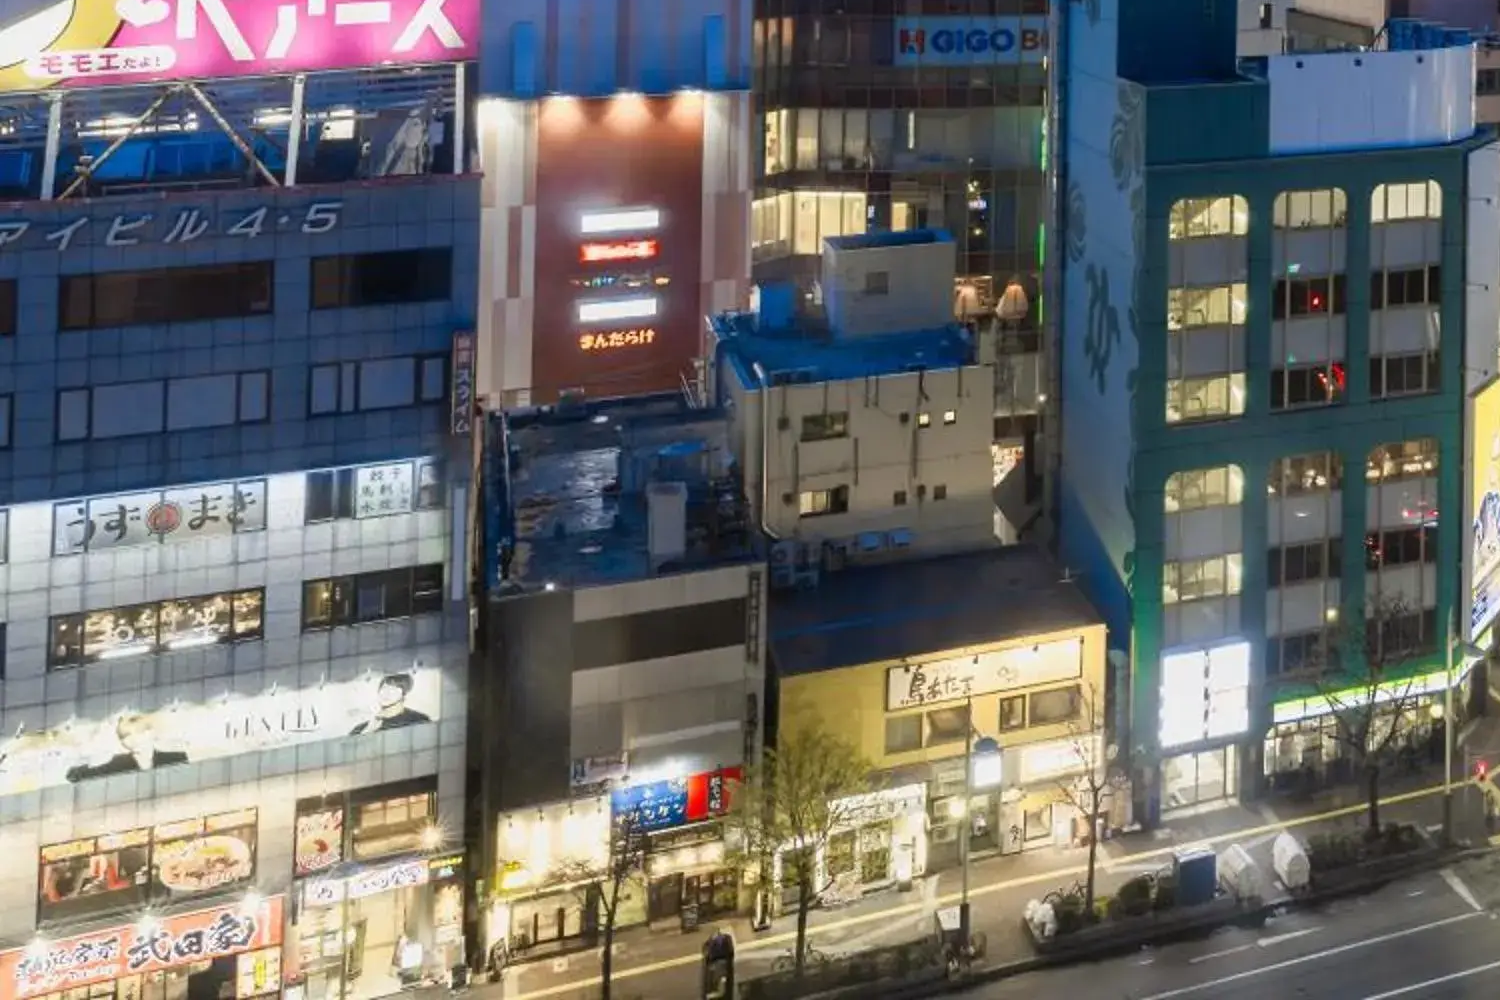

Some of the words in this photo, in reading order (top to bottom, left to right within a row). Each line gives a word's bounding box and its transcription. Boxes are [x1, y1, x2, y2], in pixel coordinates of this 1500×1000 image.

[579, 329, 655, 350] まんだらけ
[127, 911, 256, 970] 武田家
